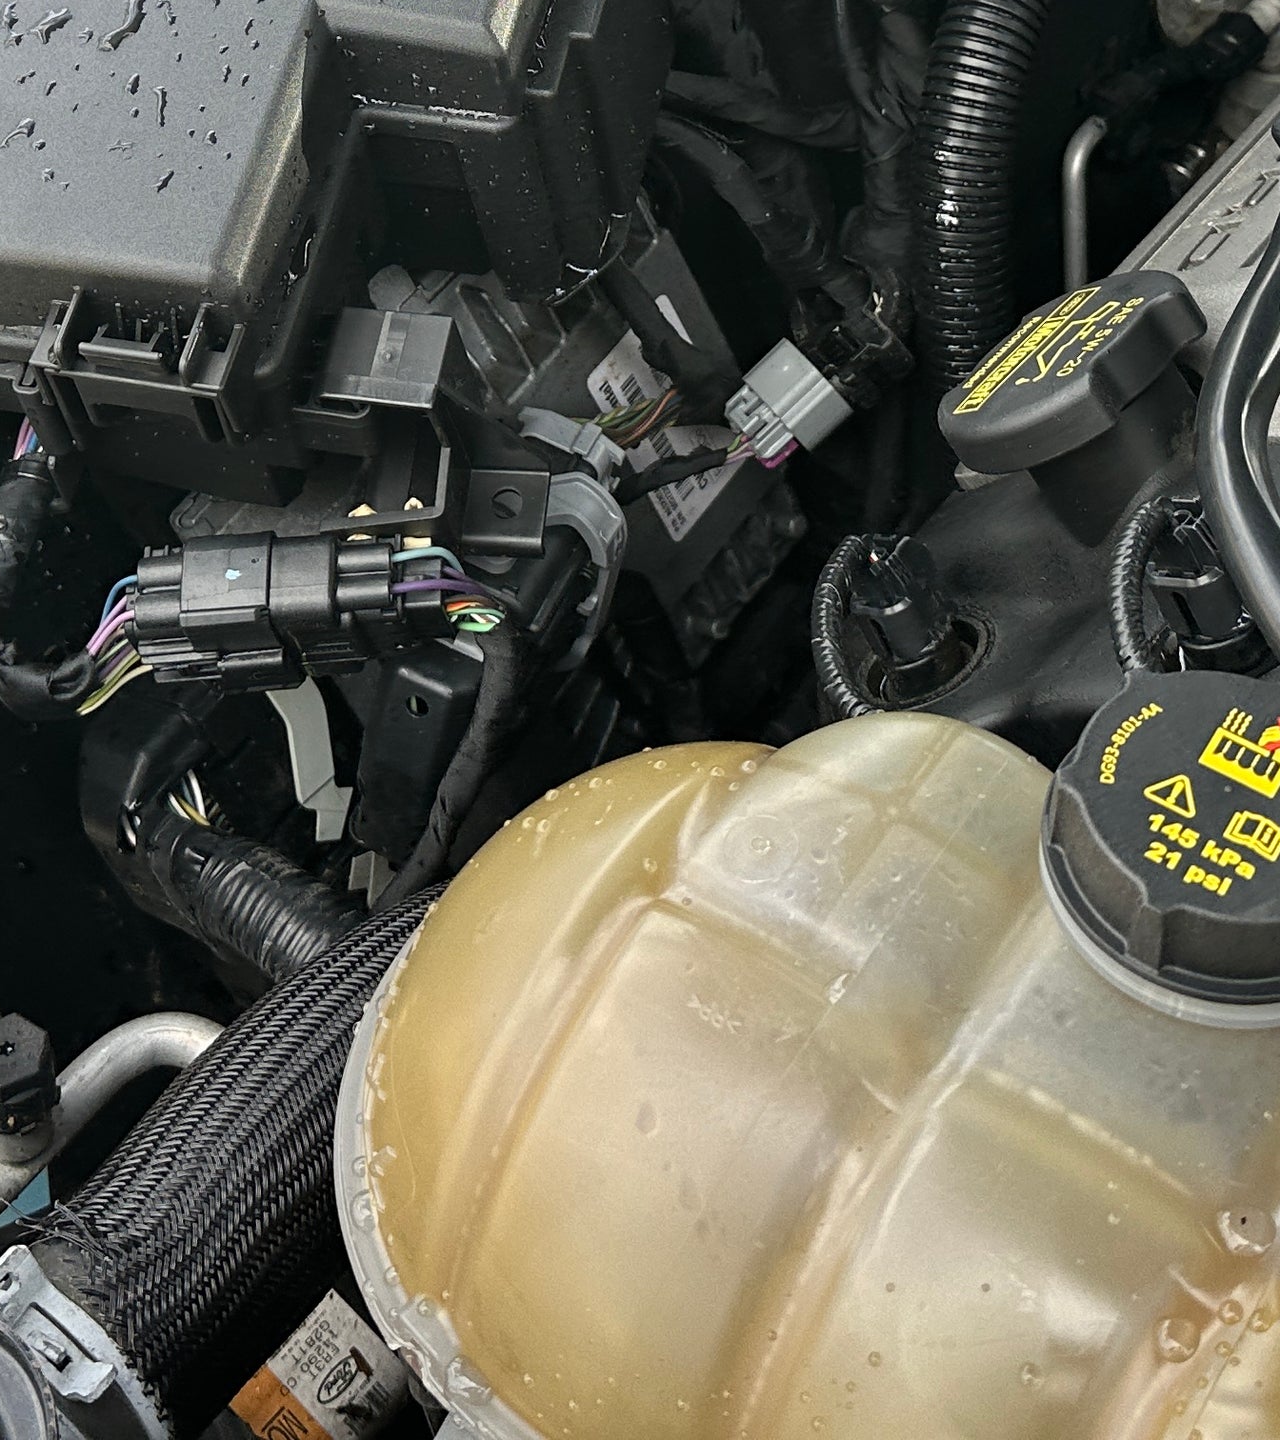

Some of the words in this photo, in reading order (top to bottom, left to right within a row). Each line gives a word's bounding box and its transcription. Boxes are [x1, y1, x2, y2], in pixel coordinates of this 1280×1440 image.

[1106, 297, 1144, 326] SAE
[962, 316, 1042, 389] Recommended
[1056, 328, 1113, 377] 5W-20
[1100, 702, 1164, 785] DG93-8101-AA
[1144, 841, 1182, 870] 21
[1183, 865, 1233, 896] psi
[1148, 813, 1200, 849] 145
[1200, 839, 1256, 880] kPa
[321, 1358, 356, 1400] Ford
